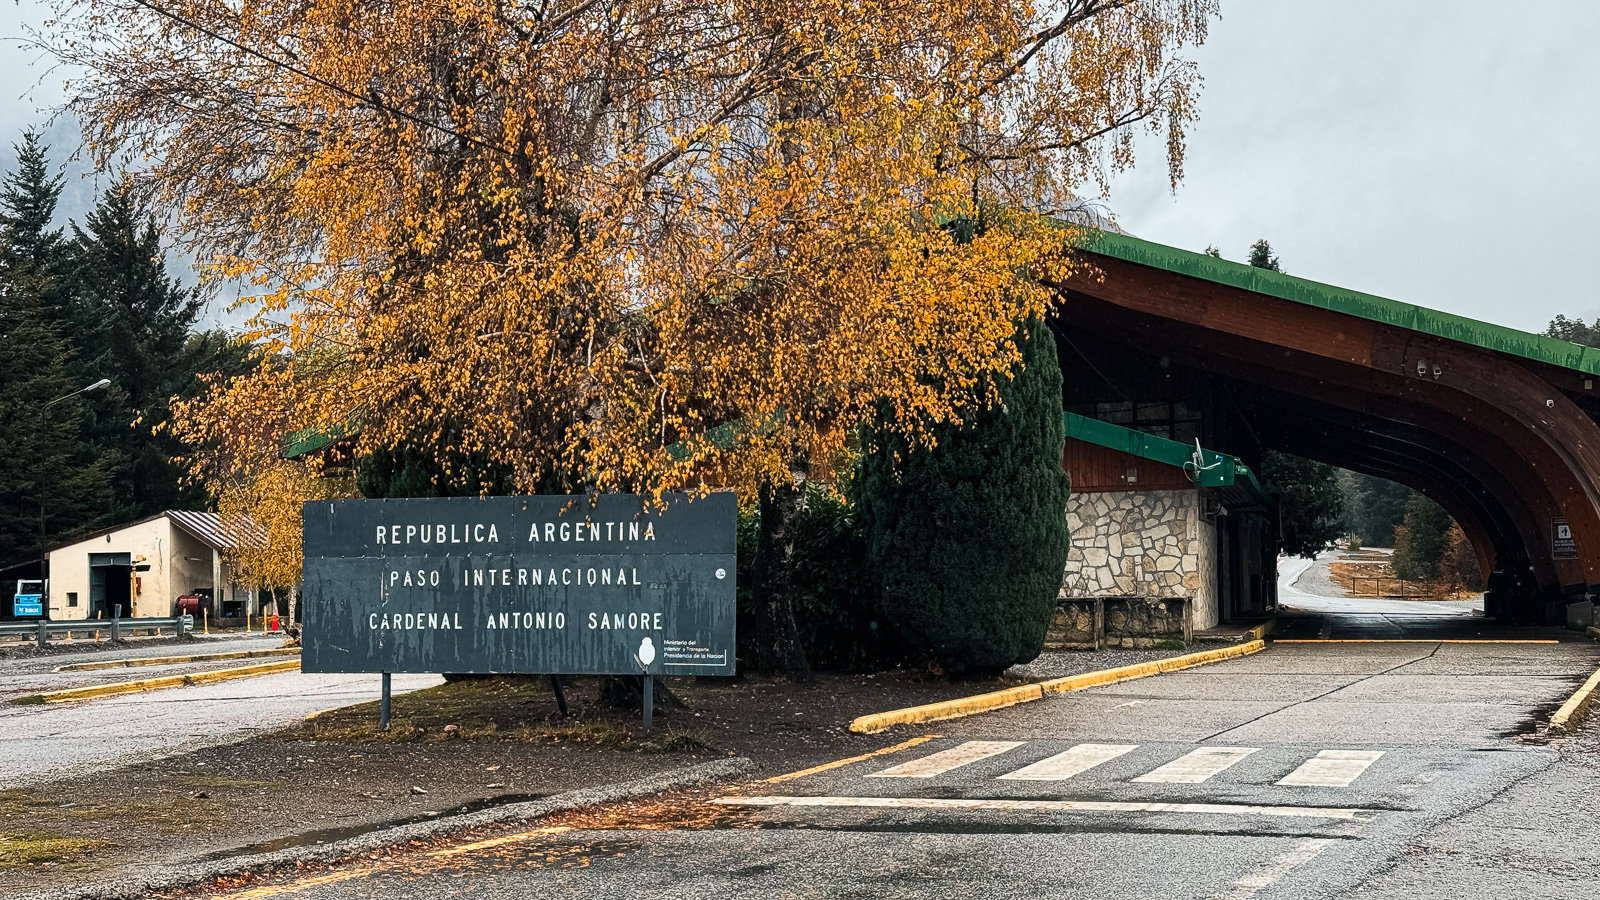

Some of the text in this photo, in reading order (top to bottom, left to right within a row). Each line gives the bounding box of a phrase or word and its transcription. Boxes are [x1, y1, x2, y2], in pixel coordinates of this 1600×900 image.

[376, 521, 656, 545] REPUBLICA ARGENTINA
[390, 568, 641, 587] PASO INTERNACIONAL
[369, 612, 662, 630] CARDENAL ANTONIO SAMORE
